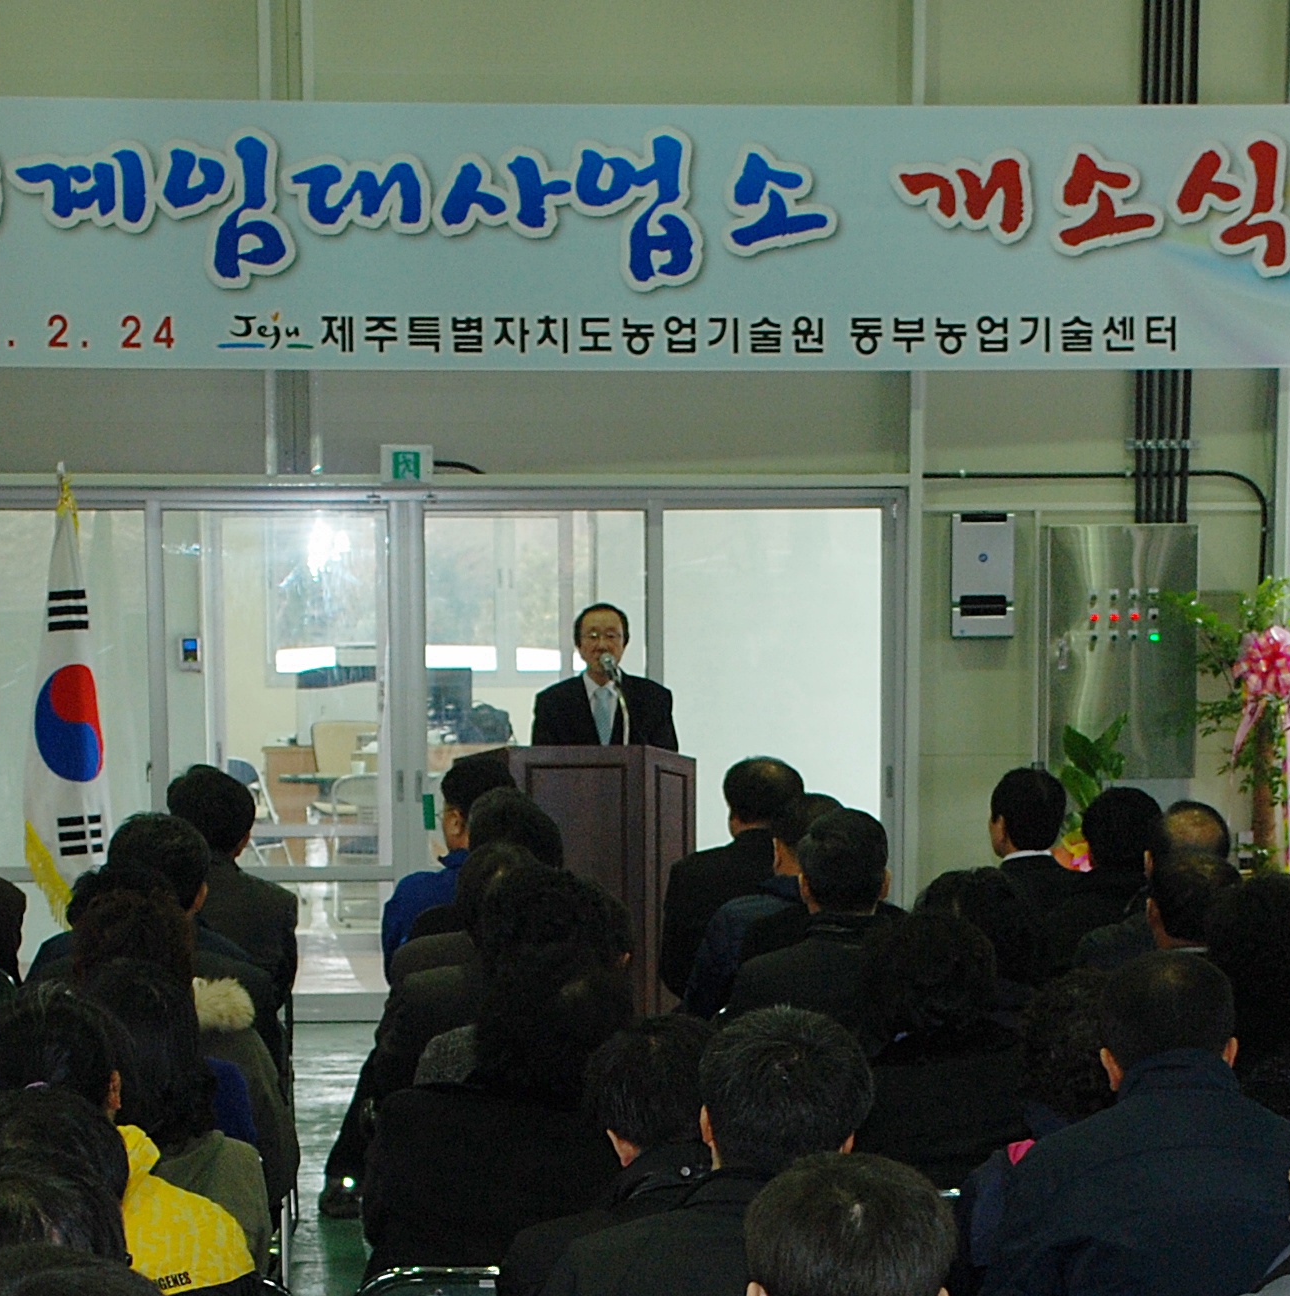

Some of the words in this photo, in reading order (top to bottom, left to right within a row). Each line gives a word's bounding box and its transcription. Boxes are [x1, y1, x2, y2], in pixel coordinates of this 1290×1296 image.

[898, 139, 1287, 269] 개소식
[47, 313, 90, 349] 2.
[120, 315, 176, 349] 24
[228, 312, 300, 350] Jeju
[319, 314, 826, 356] 제주특별자치도농업기술원
[849, 314, 1178, 356] 동부농업기술센터
[153, 1271, 193, 1291] GENES
